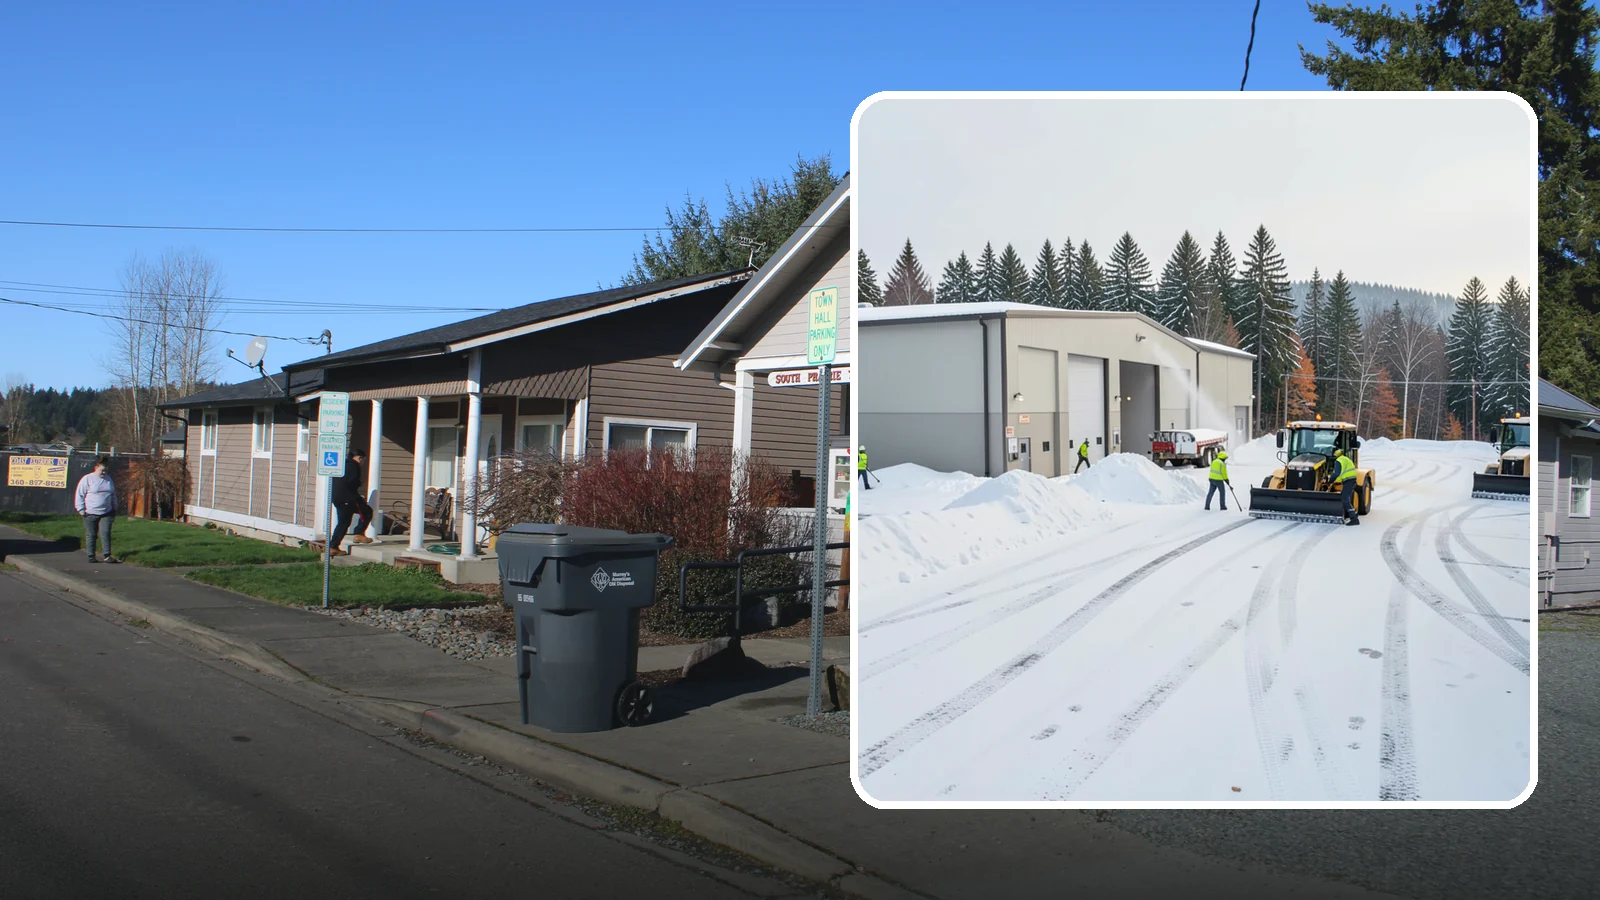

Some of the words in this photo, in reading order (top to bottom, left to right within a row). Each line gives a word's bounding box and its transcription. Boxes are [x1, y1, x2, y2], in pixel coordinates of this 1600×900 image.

[815, 294, 833, 308] TOWN
[814, 311, 831, 324] HALL
[810, 326, 835, 340] PARKING
[813, 343, 831, 357] ONLY
[775, 373, 801, 384] SOUTH
[320, 436, 344, 444] RESERVED
[321, 443, 342, 451] PARKING
[10, 479, 65, 488] 360-897-8625
